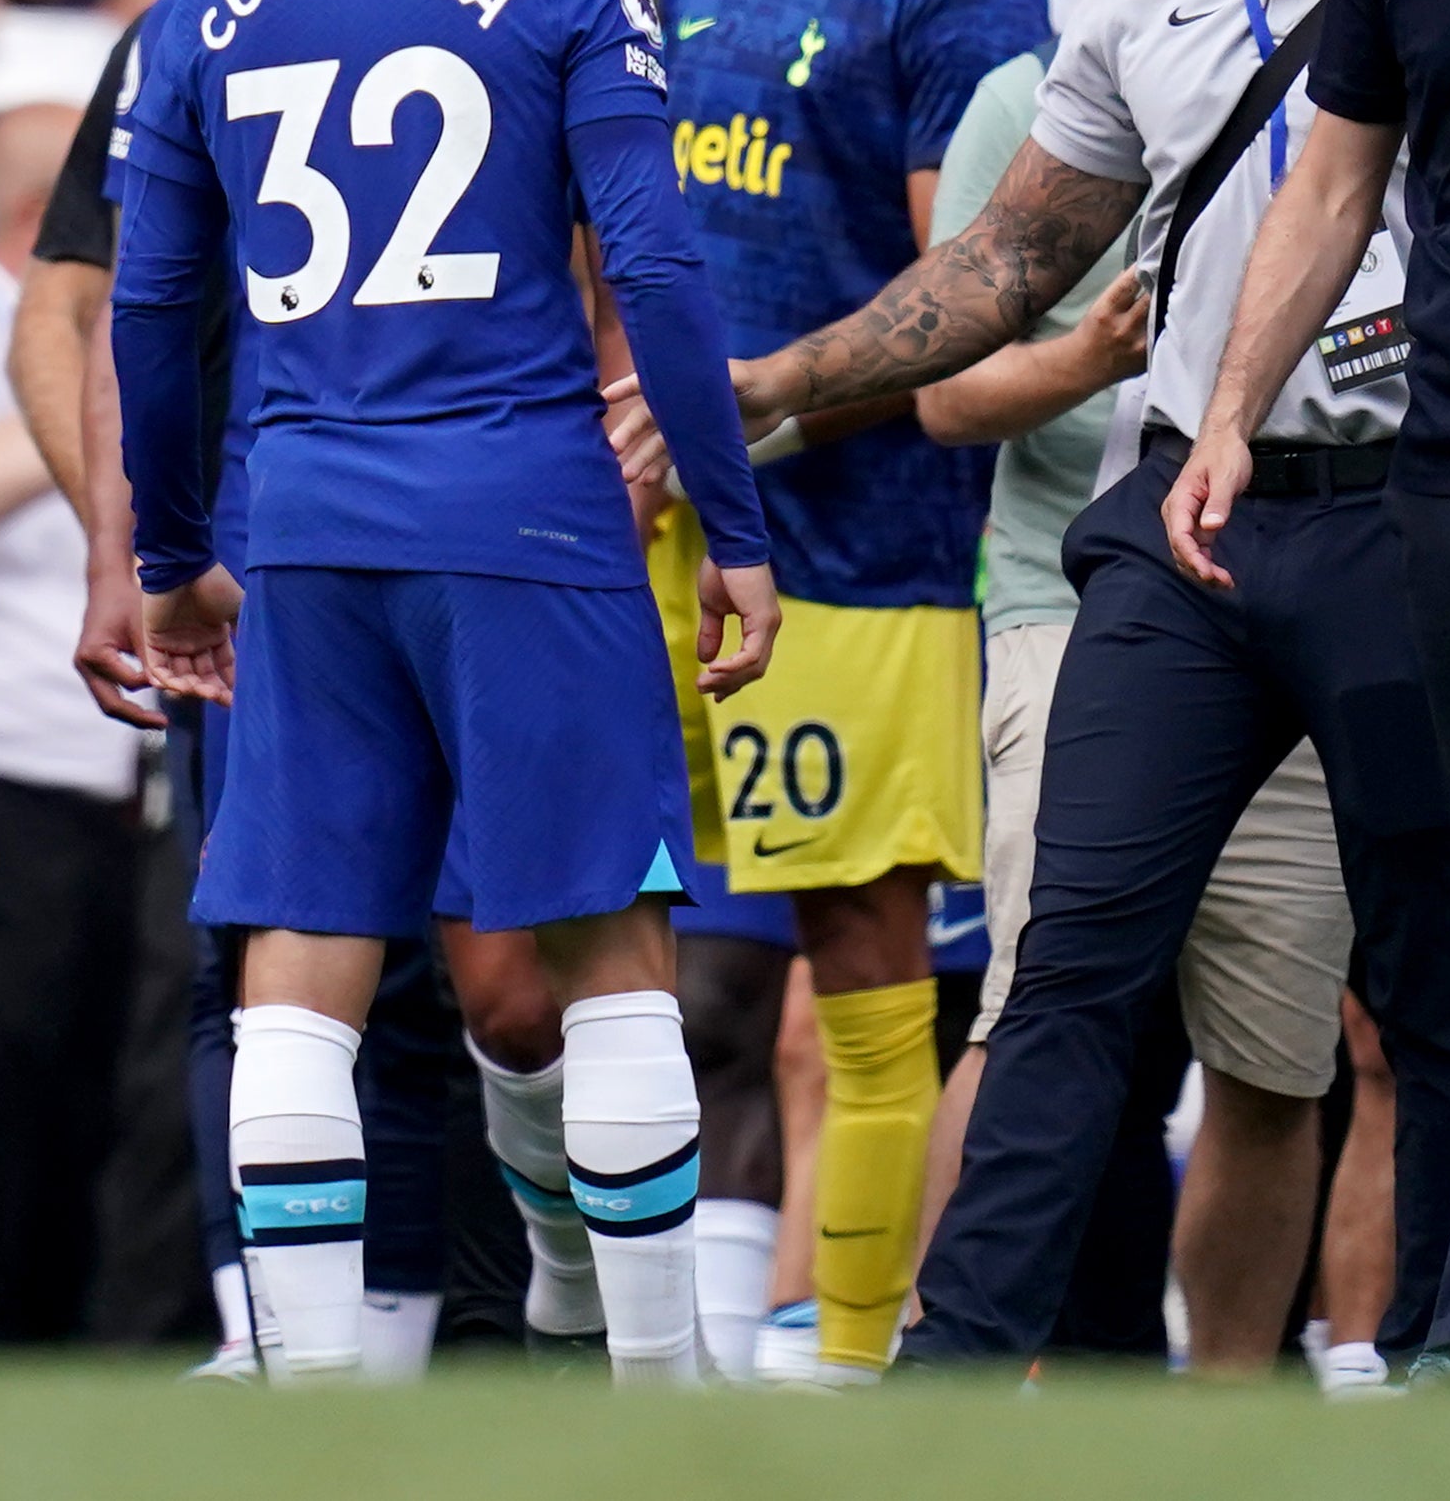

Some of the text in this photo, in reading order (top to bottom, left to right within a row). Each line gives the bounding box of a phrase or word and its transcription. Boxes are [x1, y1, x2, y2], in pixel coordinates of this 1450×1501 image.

[225, 44, 501, 325] 32
[673, 112, 792, 199] getir
[723, 720, 844, 820] 20
